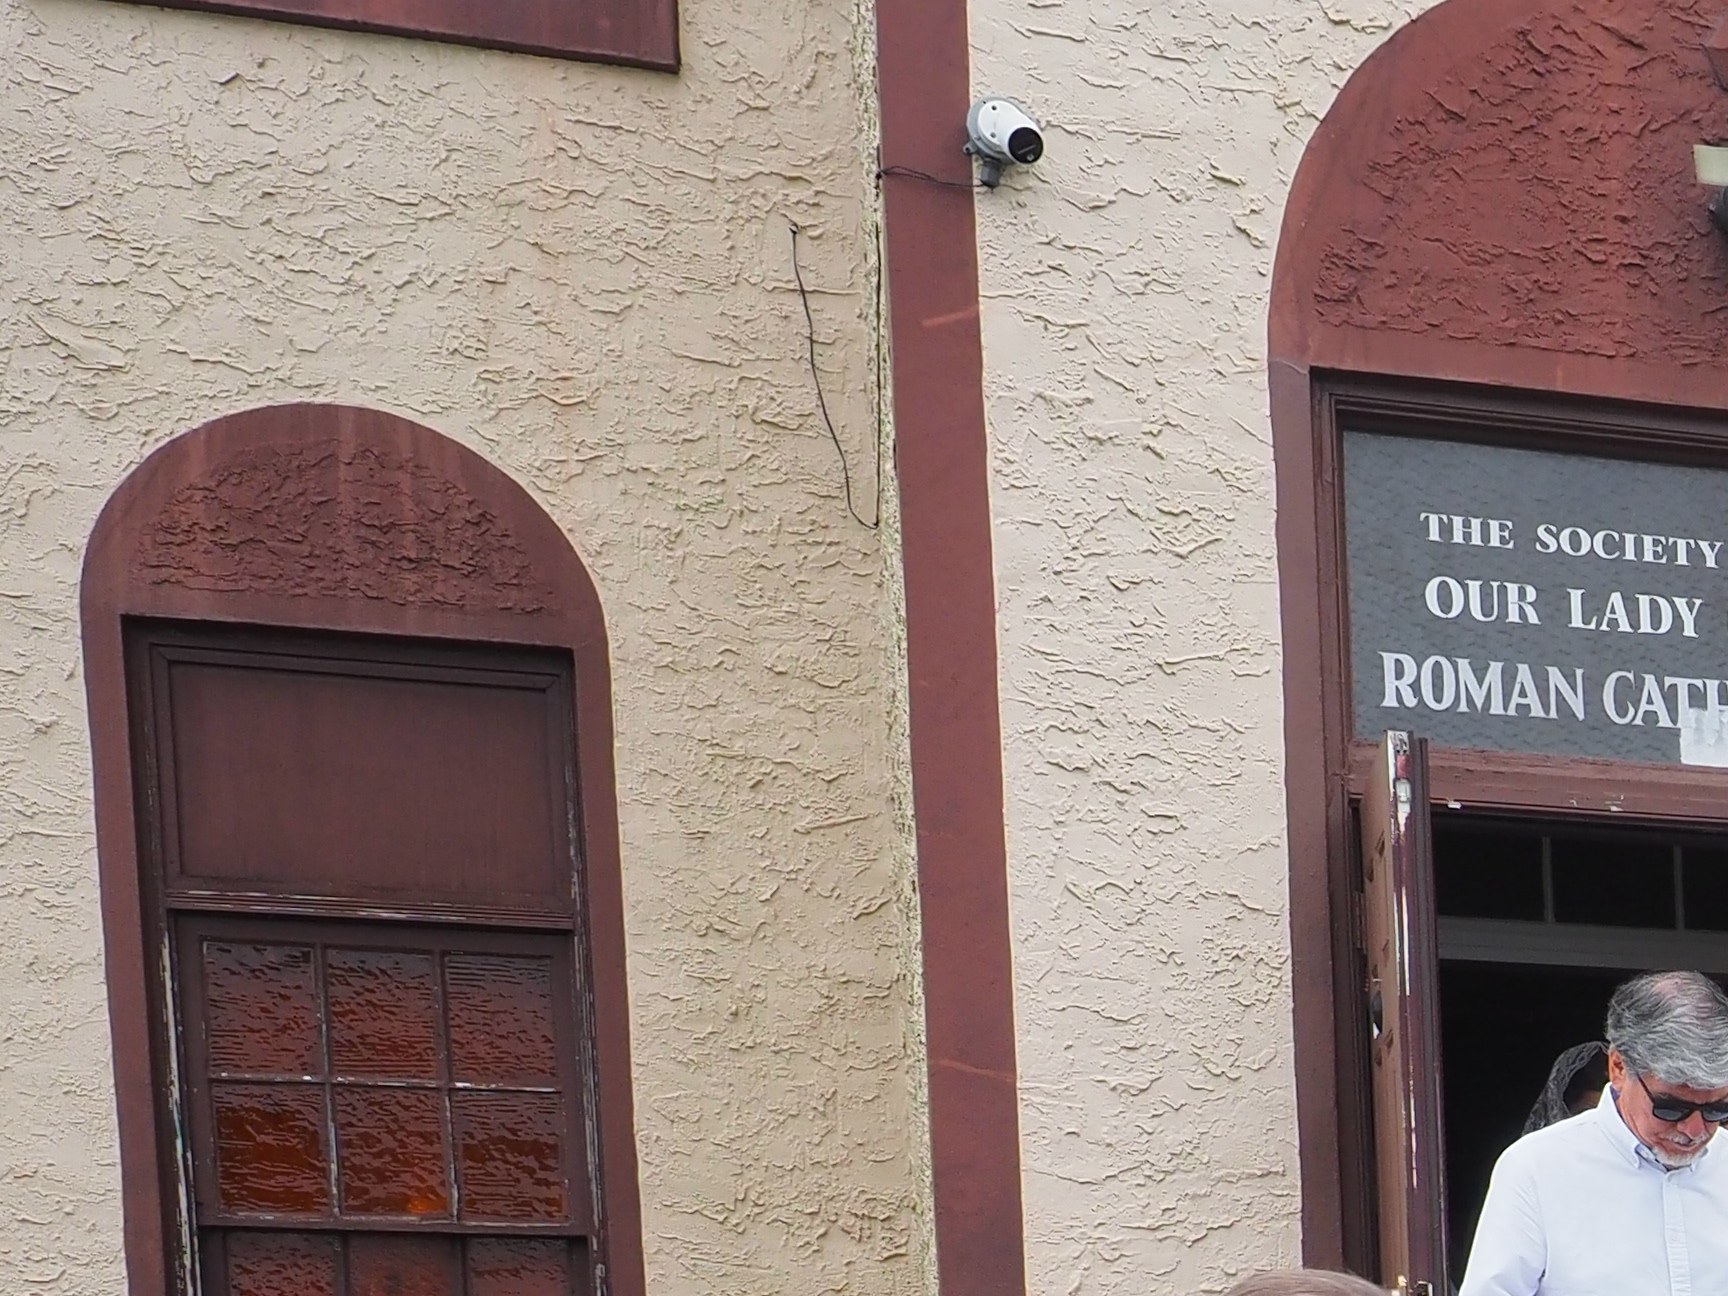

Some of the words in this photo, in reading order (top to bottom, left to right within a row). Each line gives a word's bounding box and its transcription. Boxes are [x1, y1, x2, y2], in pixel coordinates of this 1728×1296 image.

[1419, 512, 1515, 550] THE
[1535, 523, 1724, 569] SOCIETY
[1424, 575, 1542, 626] OUR
[1566, 587, 1704, 639] LADY
[1378, 650, 1585, 722] ROMAN
